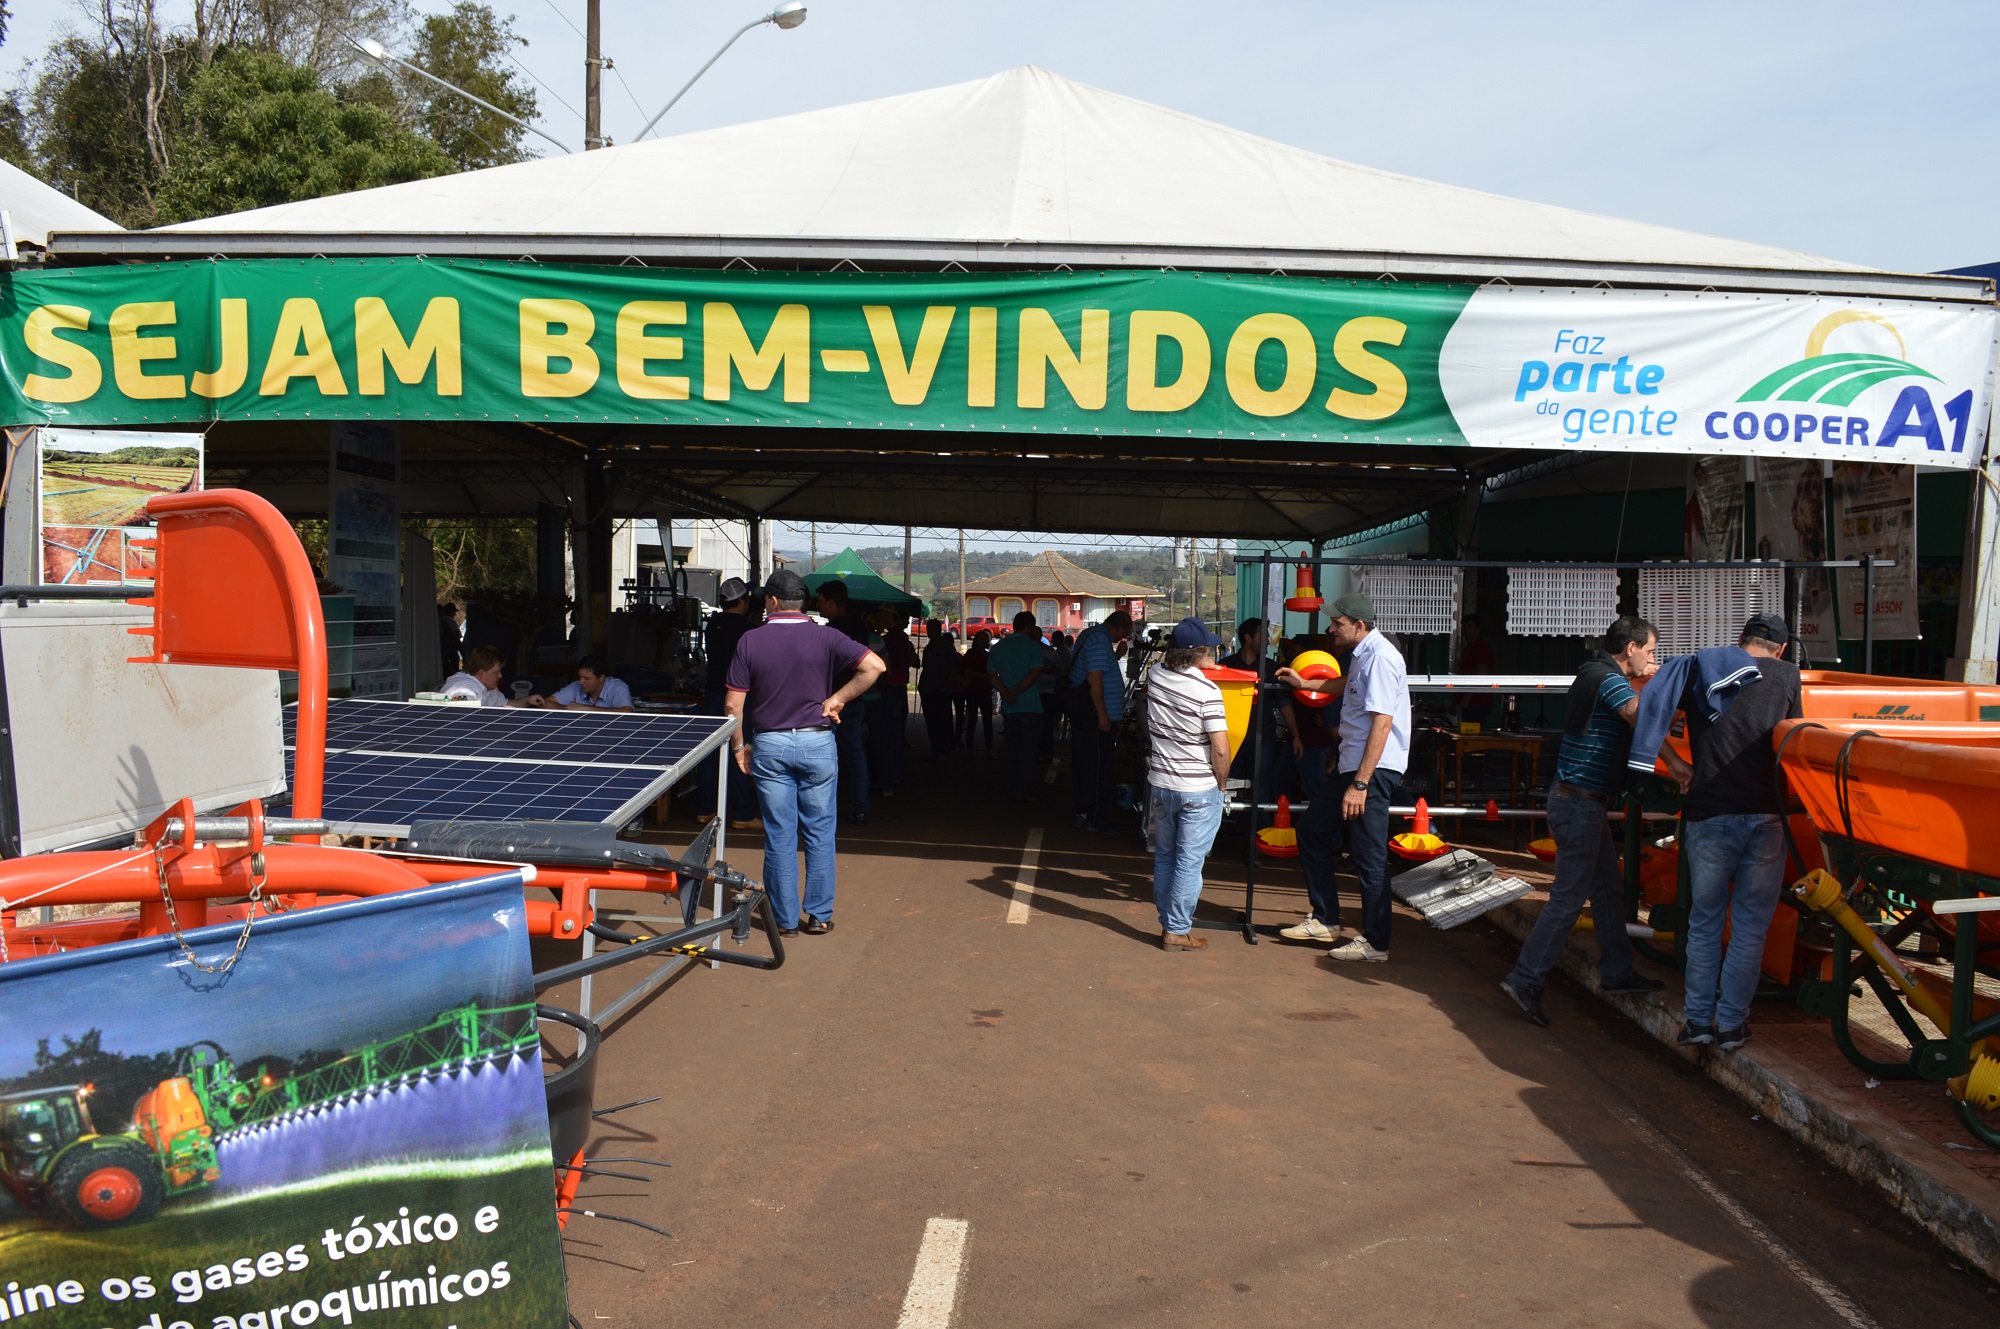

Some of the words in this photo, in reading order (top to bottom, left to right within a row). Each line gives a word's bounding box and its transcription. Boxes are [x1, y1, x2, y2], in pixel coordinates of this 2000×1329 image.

[22, 297, 463, 403] SEJAM
[519, 298, 1408, 421] BEM-VINDOS
[1554, 329, 1606, 355] Faz
[1514, 355, 1665, 402] parte
[1536, 398, 1560, 415] da
[1563, 404, 1678, 443] gente
[1705, 411, 1869, 446] COOPER
[1875, 385, 1974, 453] A1
[101, 1275, 156, 1300] os
[171, 1244, 309, 1303] gases
[321, 1206, 459, 1261] tóxico
[474, 1205, 499, 1233] e
[212, 1261, 511, 1329] agroquímicos
